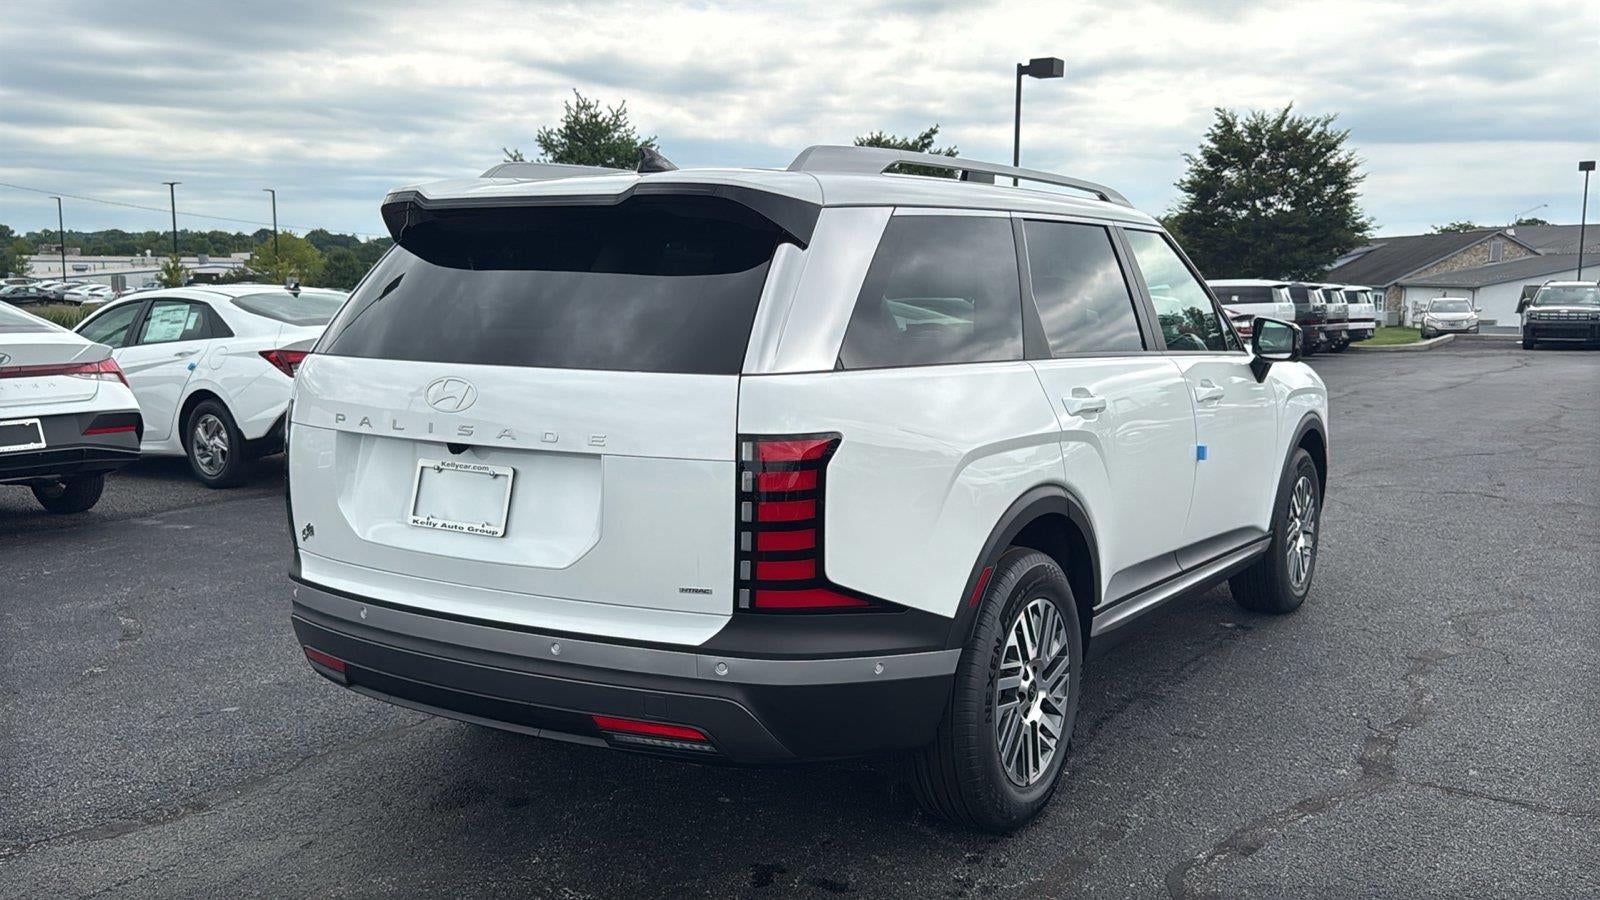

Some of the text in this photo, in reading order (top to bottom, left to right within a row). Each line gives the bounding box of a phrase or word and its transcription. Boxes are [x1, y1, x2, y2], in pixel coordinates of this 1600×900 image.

[335, 413, 607, 447] PALISADE
[441, 461, 490, 471] Kellycar.com
[412, 518, 499, 536] Kelly Auto Group
[985, 637, 1002, 723] NEXEN
